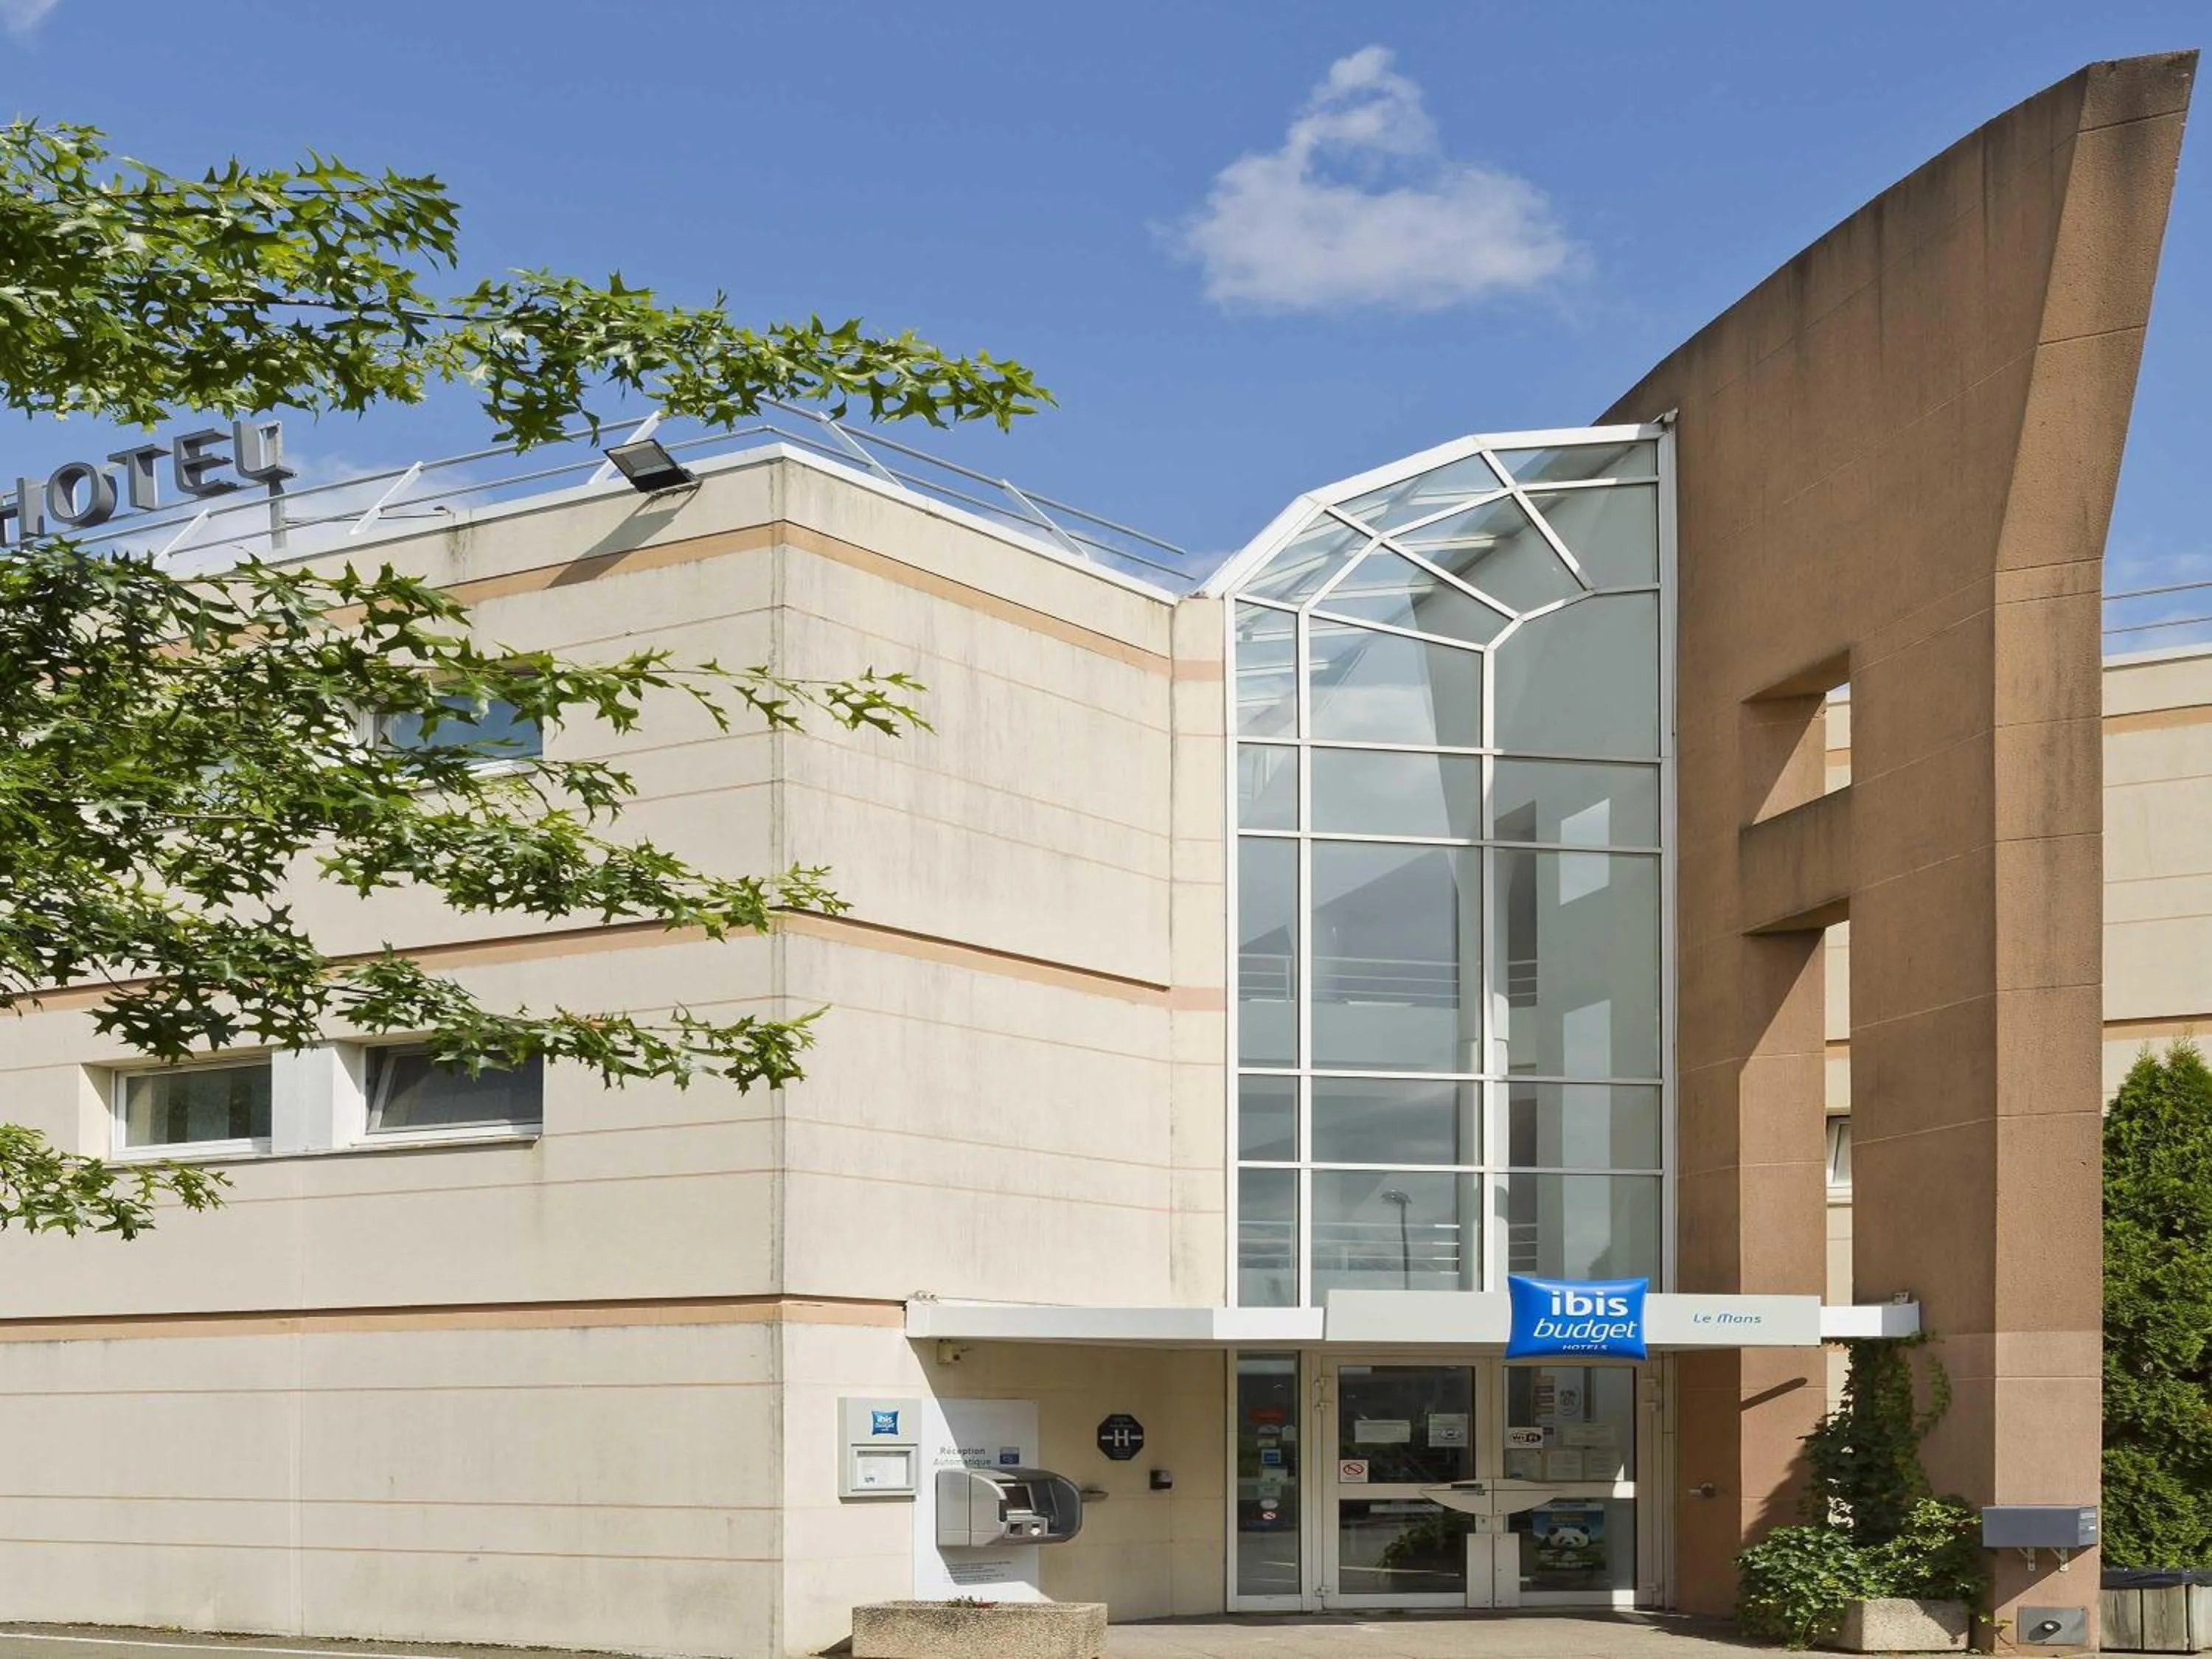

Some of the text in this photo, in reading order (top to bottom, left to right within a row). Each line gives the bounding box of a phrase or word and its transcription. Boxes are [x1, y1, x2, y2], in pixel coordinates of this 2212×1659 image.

[0, 420, 296, 550] HOTEL
[1551, 1290, 1630, 1317] ibis
[1533, 1318, 1638, 1343] budget
[1693, 1312, 1762, 1324] Le Mans
[1113, 1429, 1130, 1447] H
